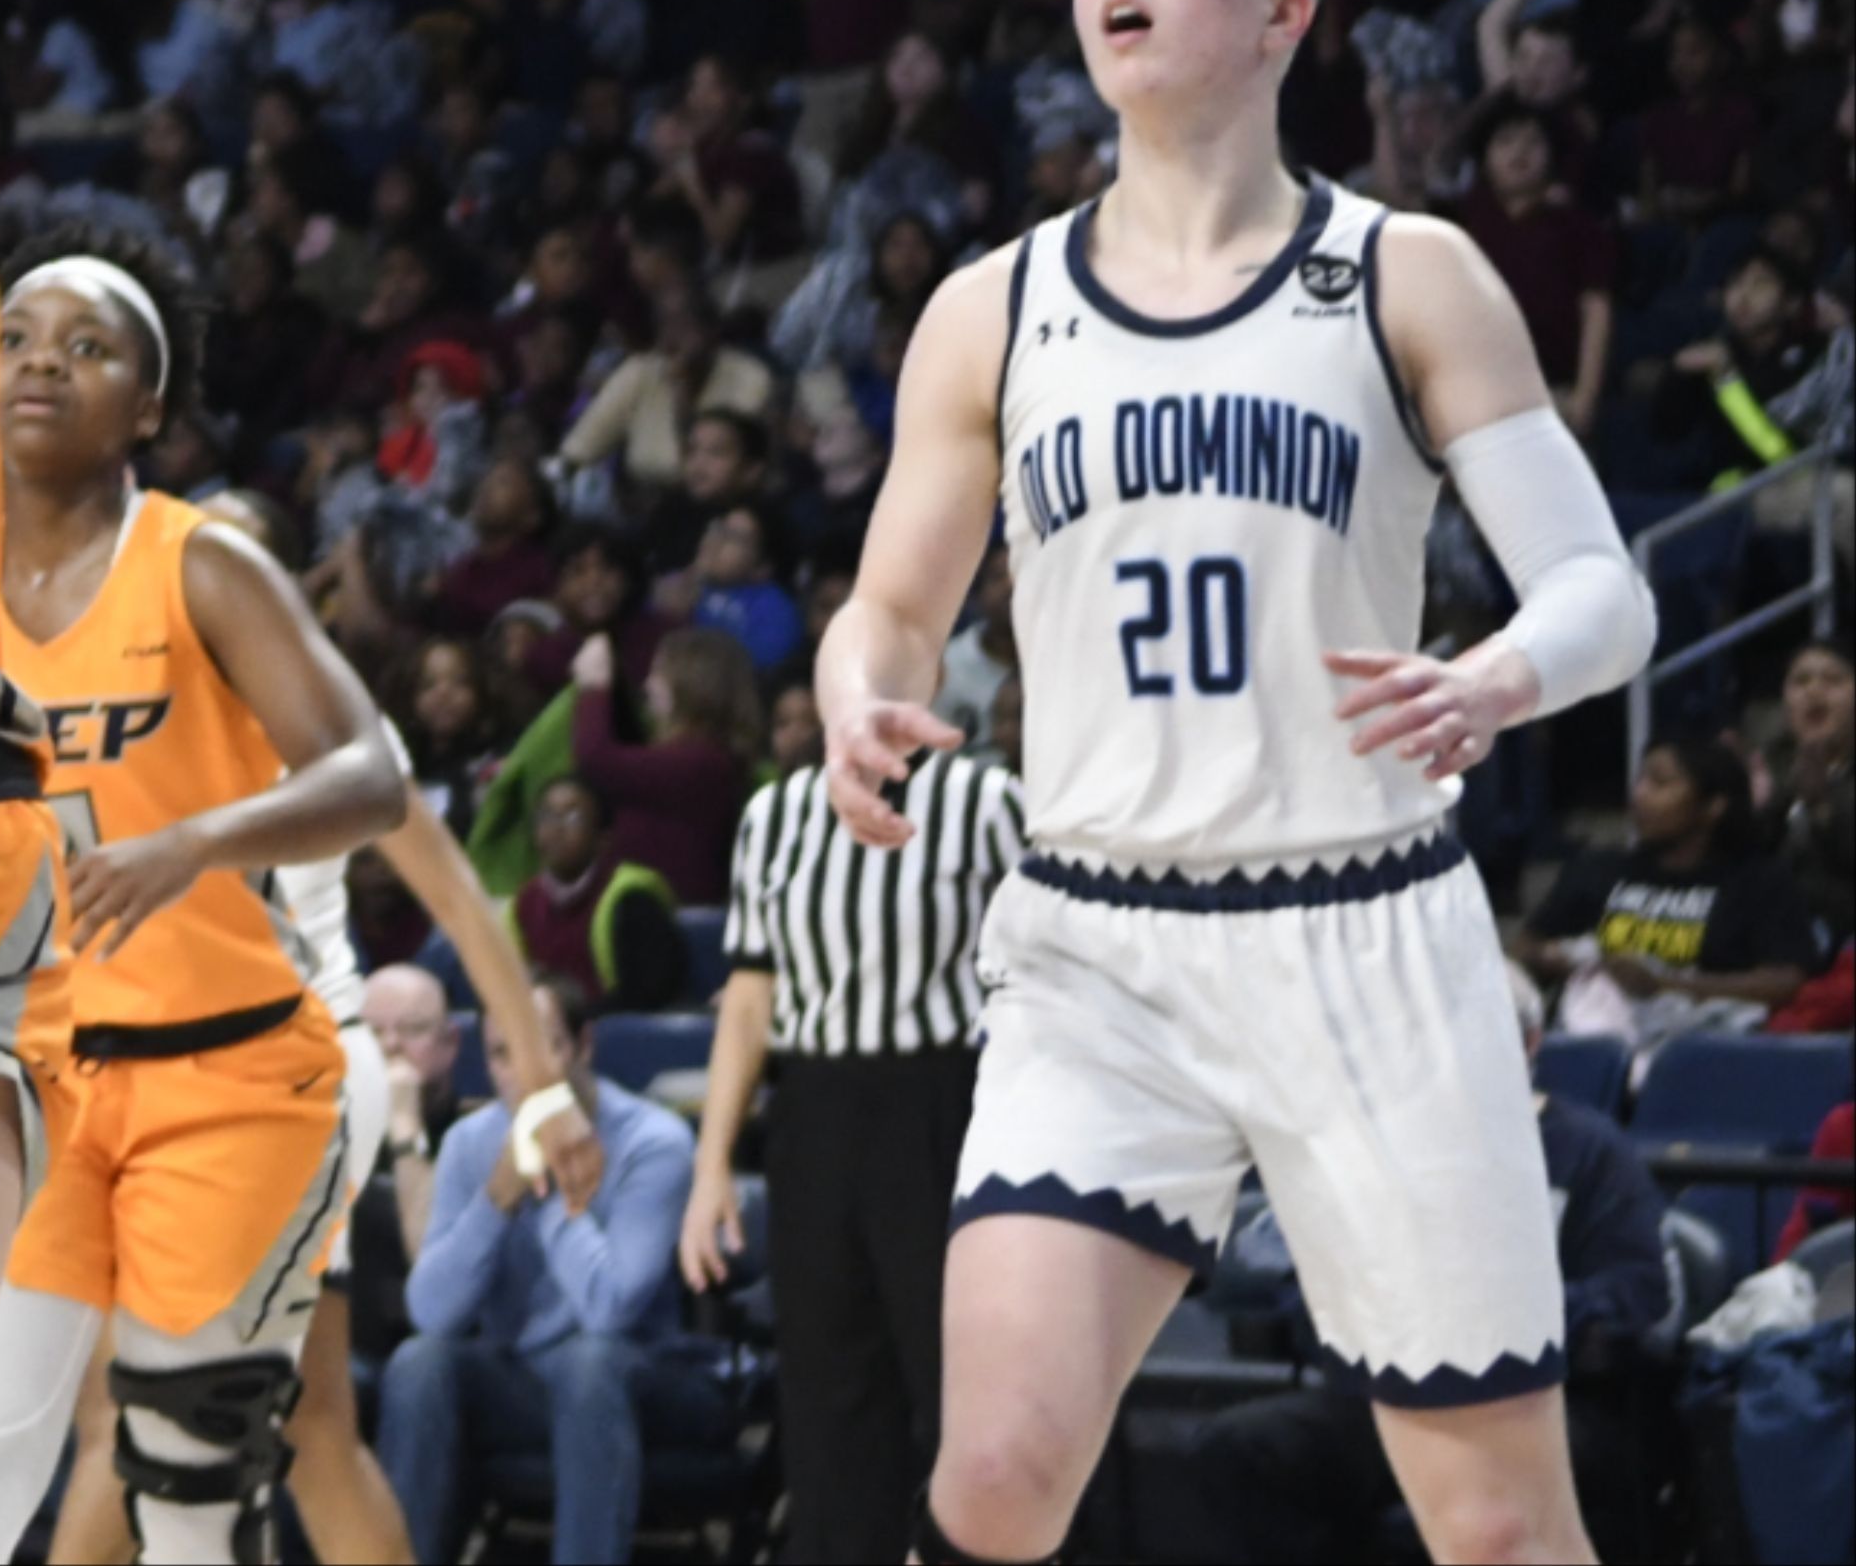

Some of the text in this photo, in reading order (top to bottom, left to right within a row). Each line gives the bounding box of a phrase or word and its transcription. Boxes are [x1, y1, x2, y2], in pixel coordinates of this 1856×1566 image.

[1019, 392, 1361, 546] OLD DOMINION
[1114, 555, 1248, 699] 20
[45, 694, 174, 764] EP
